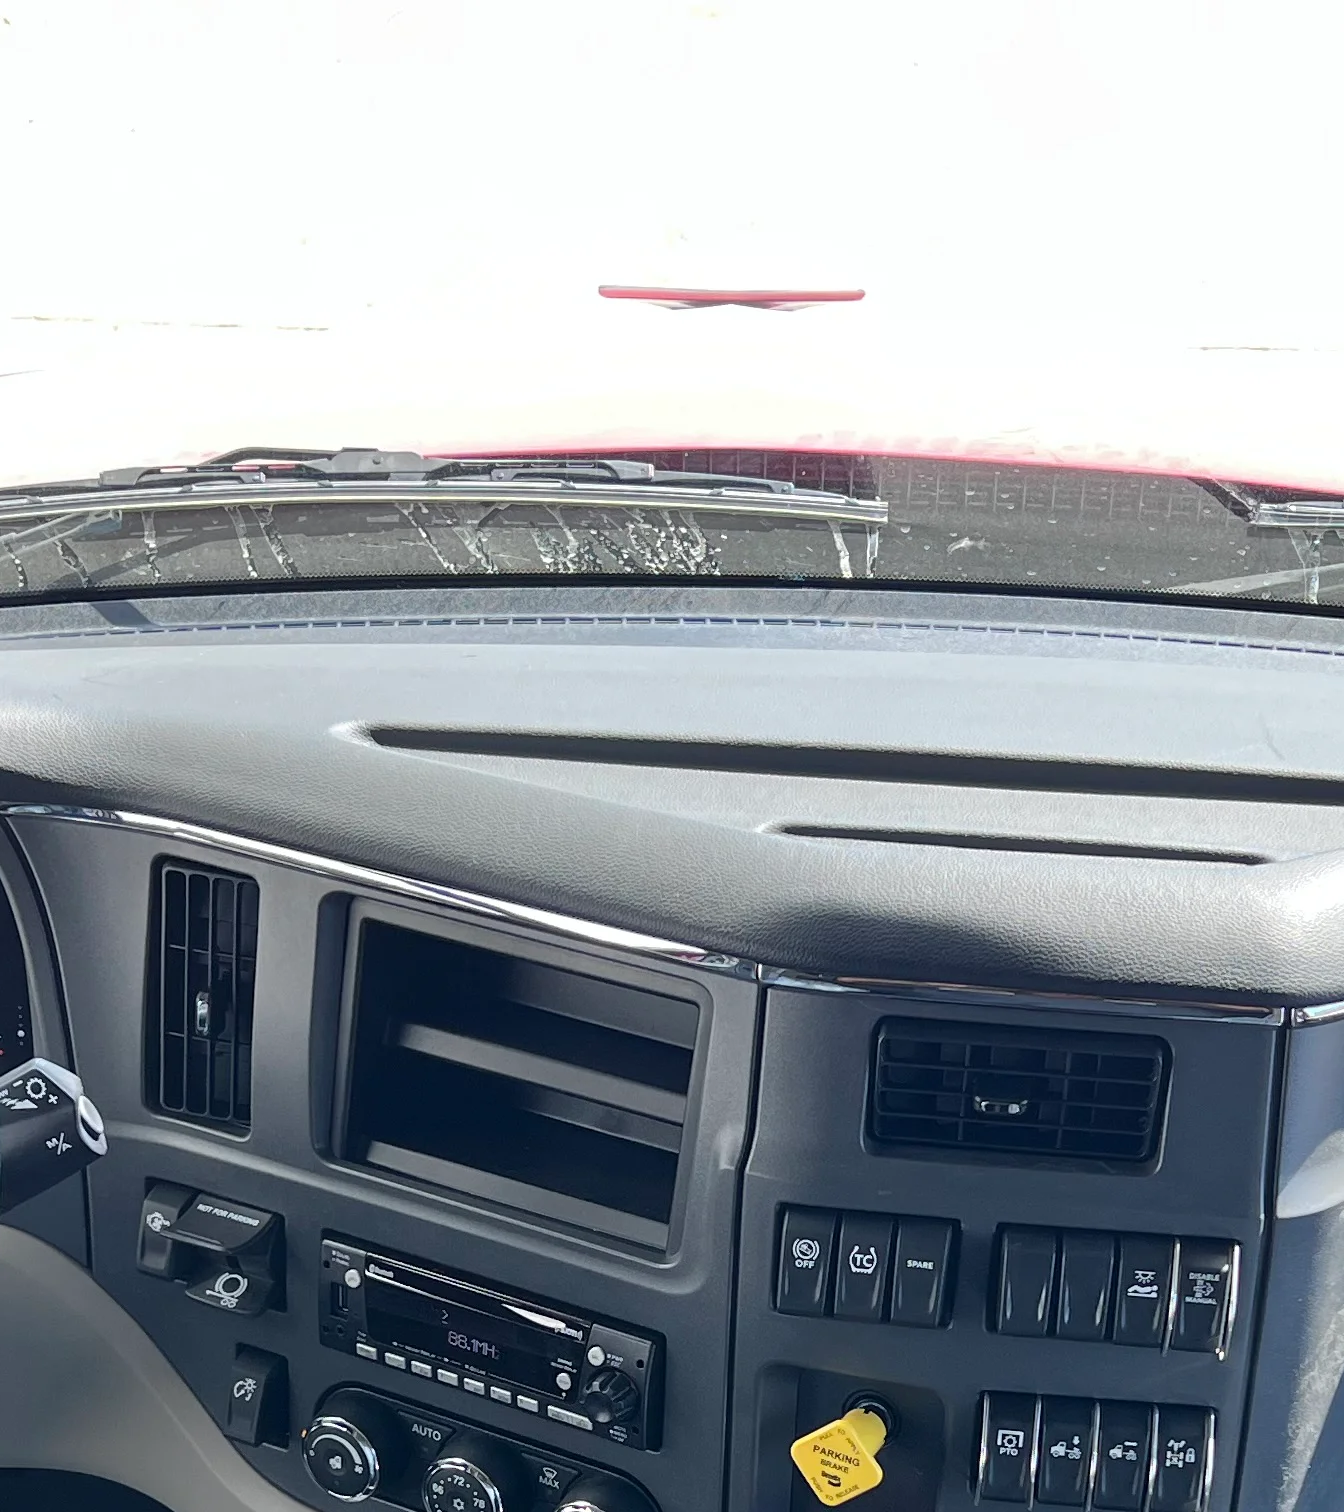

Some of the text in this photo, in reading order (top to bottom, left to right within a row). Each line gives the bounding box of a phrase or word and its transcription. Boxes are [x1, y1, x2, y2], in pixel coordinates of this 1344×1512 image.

[197, 1203, 260, 1226] NOT FOR PARKING
[795, 1259, 815, 1269] OFF
[854, 1253, 873, 1268] TC
[906, 1259, 934, 1270] SPARE
[1188, 1272, 1220, 1282] DISABLE
[411, 1422, 442, 1442] AUTO
[812, 1444, 861, 1468] PARKING
[999, 1447, 1018, 1457] PTO
[820, 1458, 849, 1474] BRAKE
[453, 1474, 466, 1487] 72
[538, 1474, 560, 1490] MAX
[473, 1497, 486, 1509] 78
